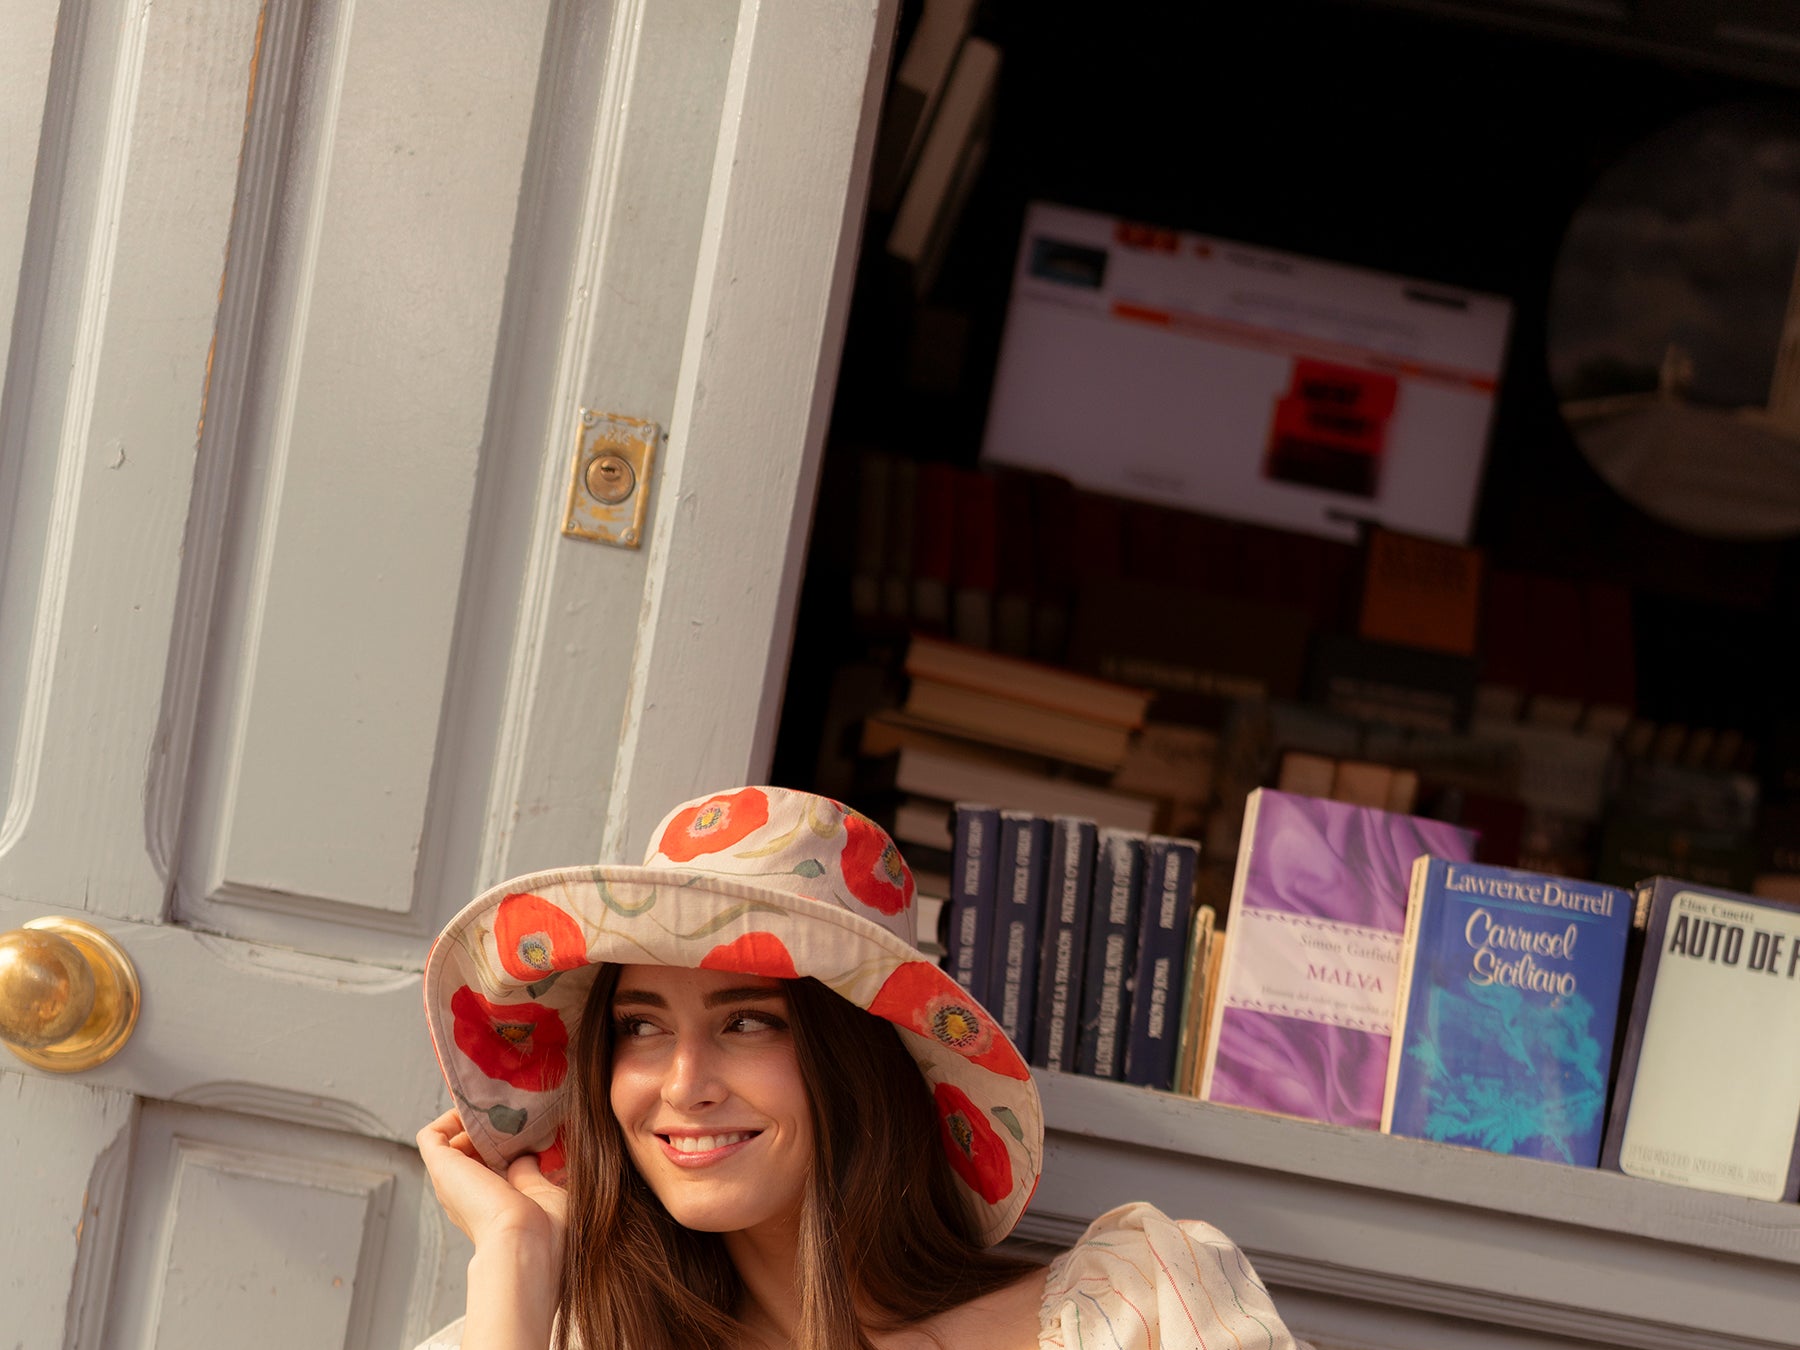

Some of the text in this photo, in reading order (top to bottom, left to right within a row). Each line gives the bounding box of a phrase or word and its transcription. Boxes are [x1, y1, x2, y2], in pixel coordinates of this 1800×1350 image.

[1060, 877, 1077, 923] PATRICK
[1444, 865, 1542, 904] Lawrence
[1542, 881, 1615, 917] Durrell
[1679, 897, 1756, 925] Elias Canetti
[1299, 934, 1400, 965] Simon Garfield
[1464, 906, 1579, 960] Carrusel
[1668, 914, 1744, 966] AUTO
[1747, 930, 1786, 975] DE
[1306, 963, 1383, 994] MALVA
[1468, 946, 1577, 998] Siciliano
